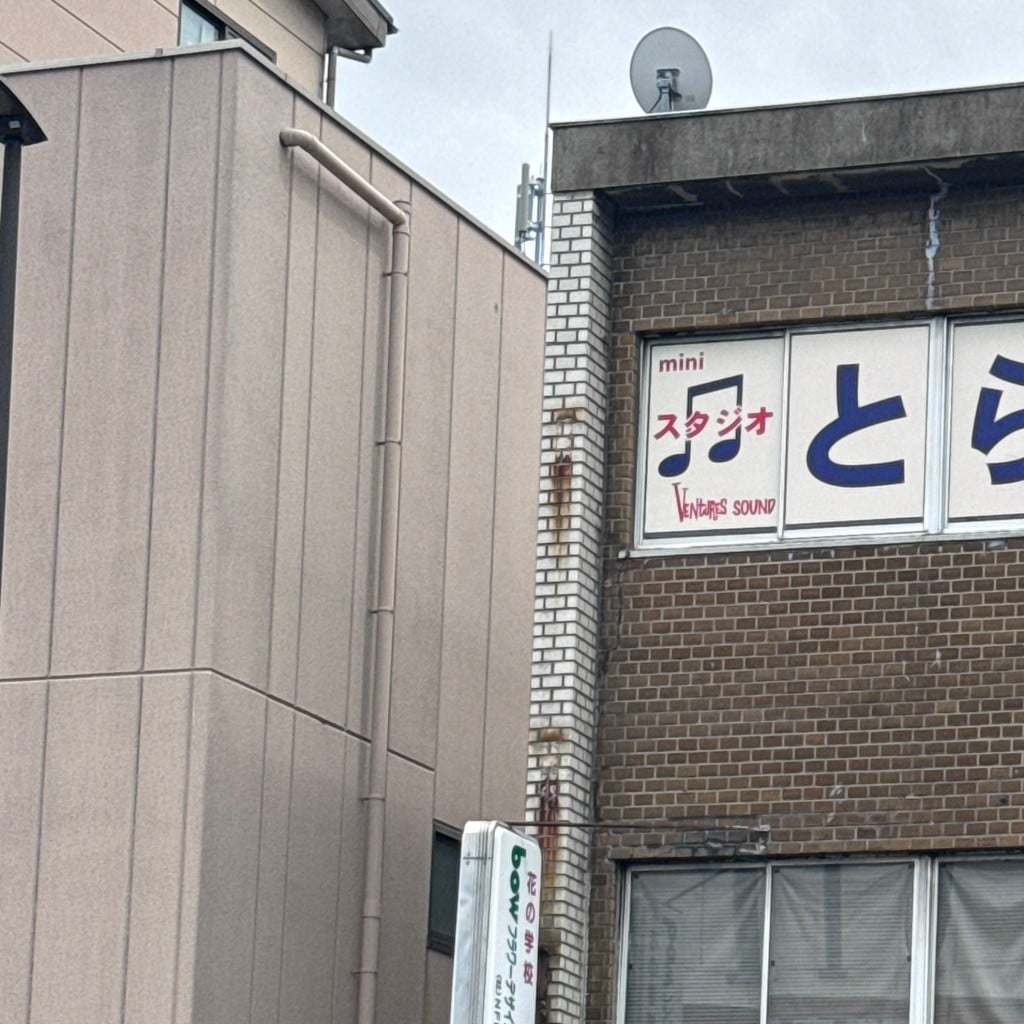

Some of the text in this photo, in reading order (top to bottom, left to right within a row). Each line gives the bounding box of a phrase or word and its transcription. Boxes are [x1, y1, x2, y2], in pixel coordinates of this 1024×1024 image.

[659, 352, 705, 373] mini
[654, 407, 774, 440] スタジオ
[732, 498, 776, 516] SOUND
